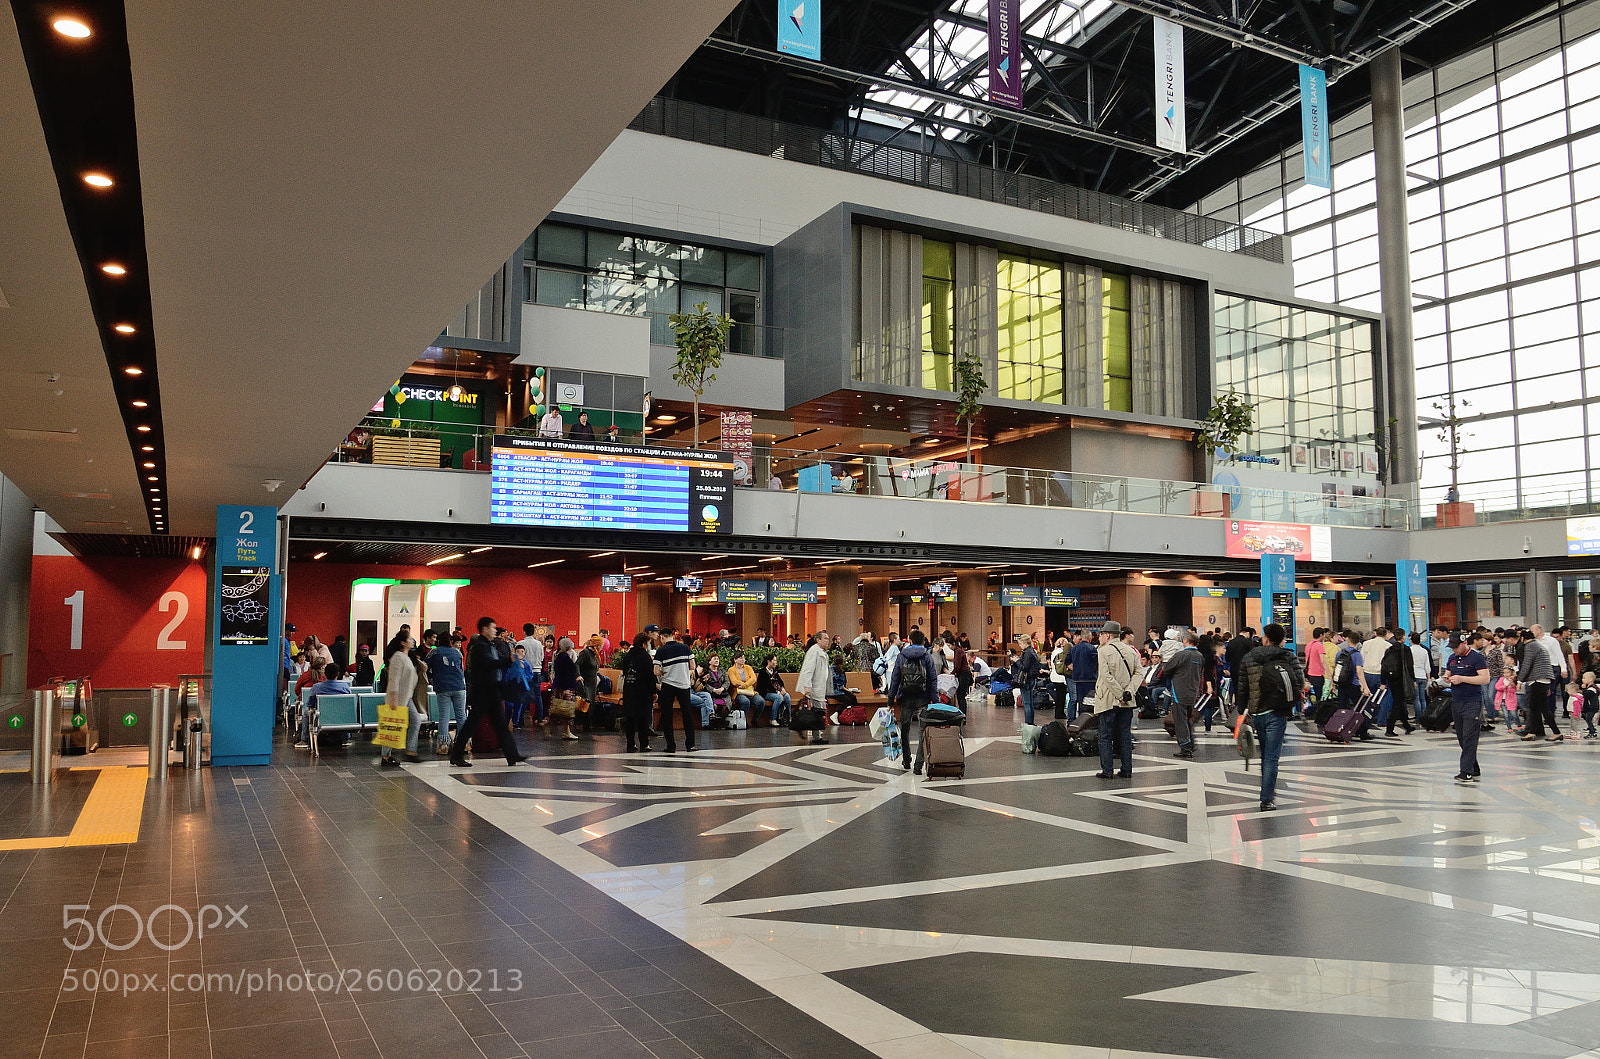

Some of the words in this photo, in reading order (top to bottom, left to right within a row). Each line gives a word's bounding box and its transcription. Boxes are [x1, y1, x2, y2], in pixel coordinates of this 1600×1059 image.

[1000, 11, 1008, 54] TENGRI
[1166, 62, 1174, 103] TENGRI
[1311, 105, 1319, 142] TENGRI
[552, 442, 595, 450] ОТПРАВЛЕНИЕ
[239, 511, 254, 534] 2
[236, 538, 258, 547] Жол
[1279, 558, 1286, 572] 3
[1413, 563, 1419, 577] 4
[64, 590, 84, 650] 1
[157, 591, 189, 650] 2
